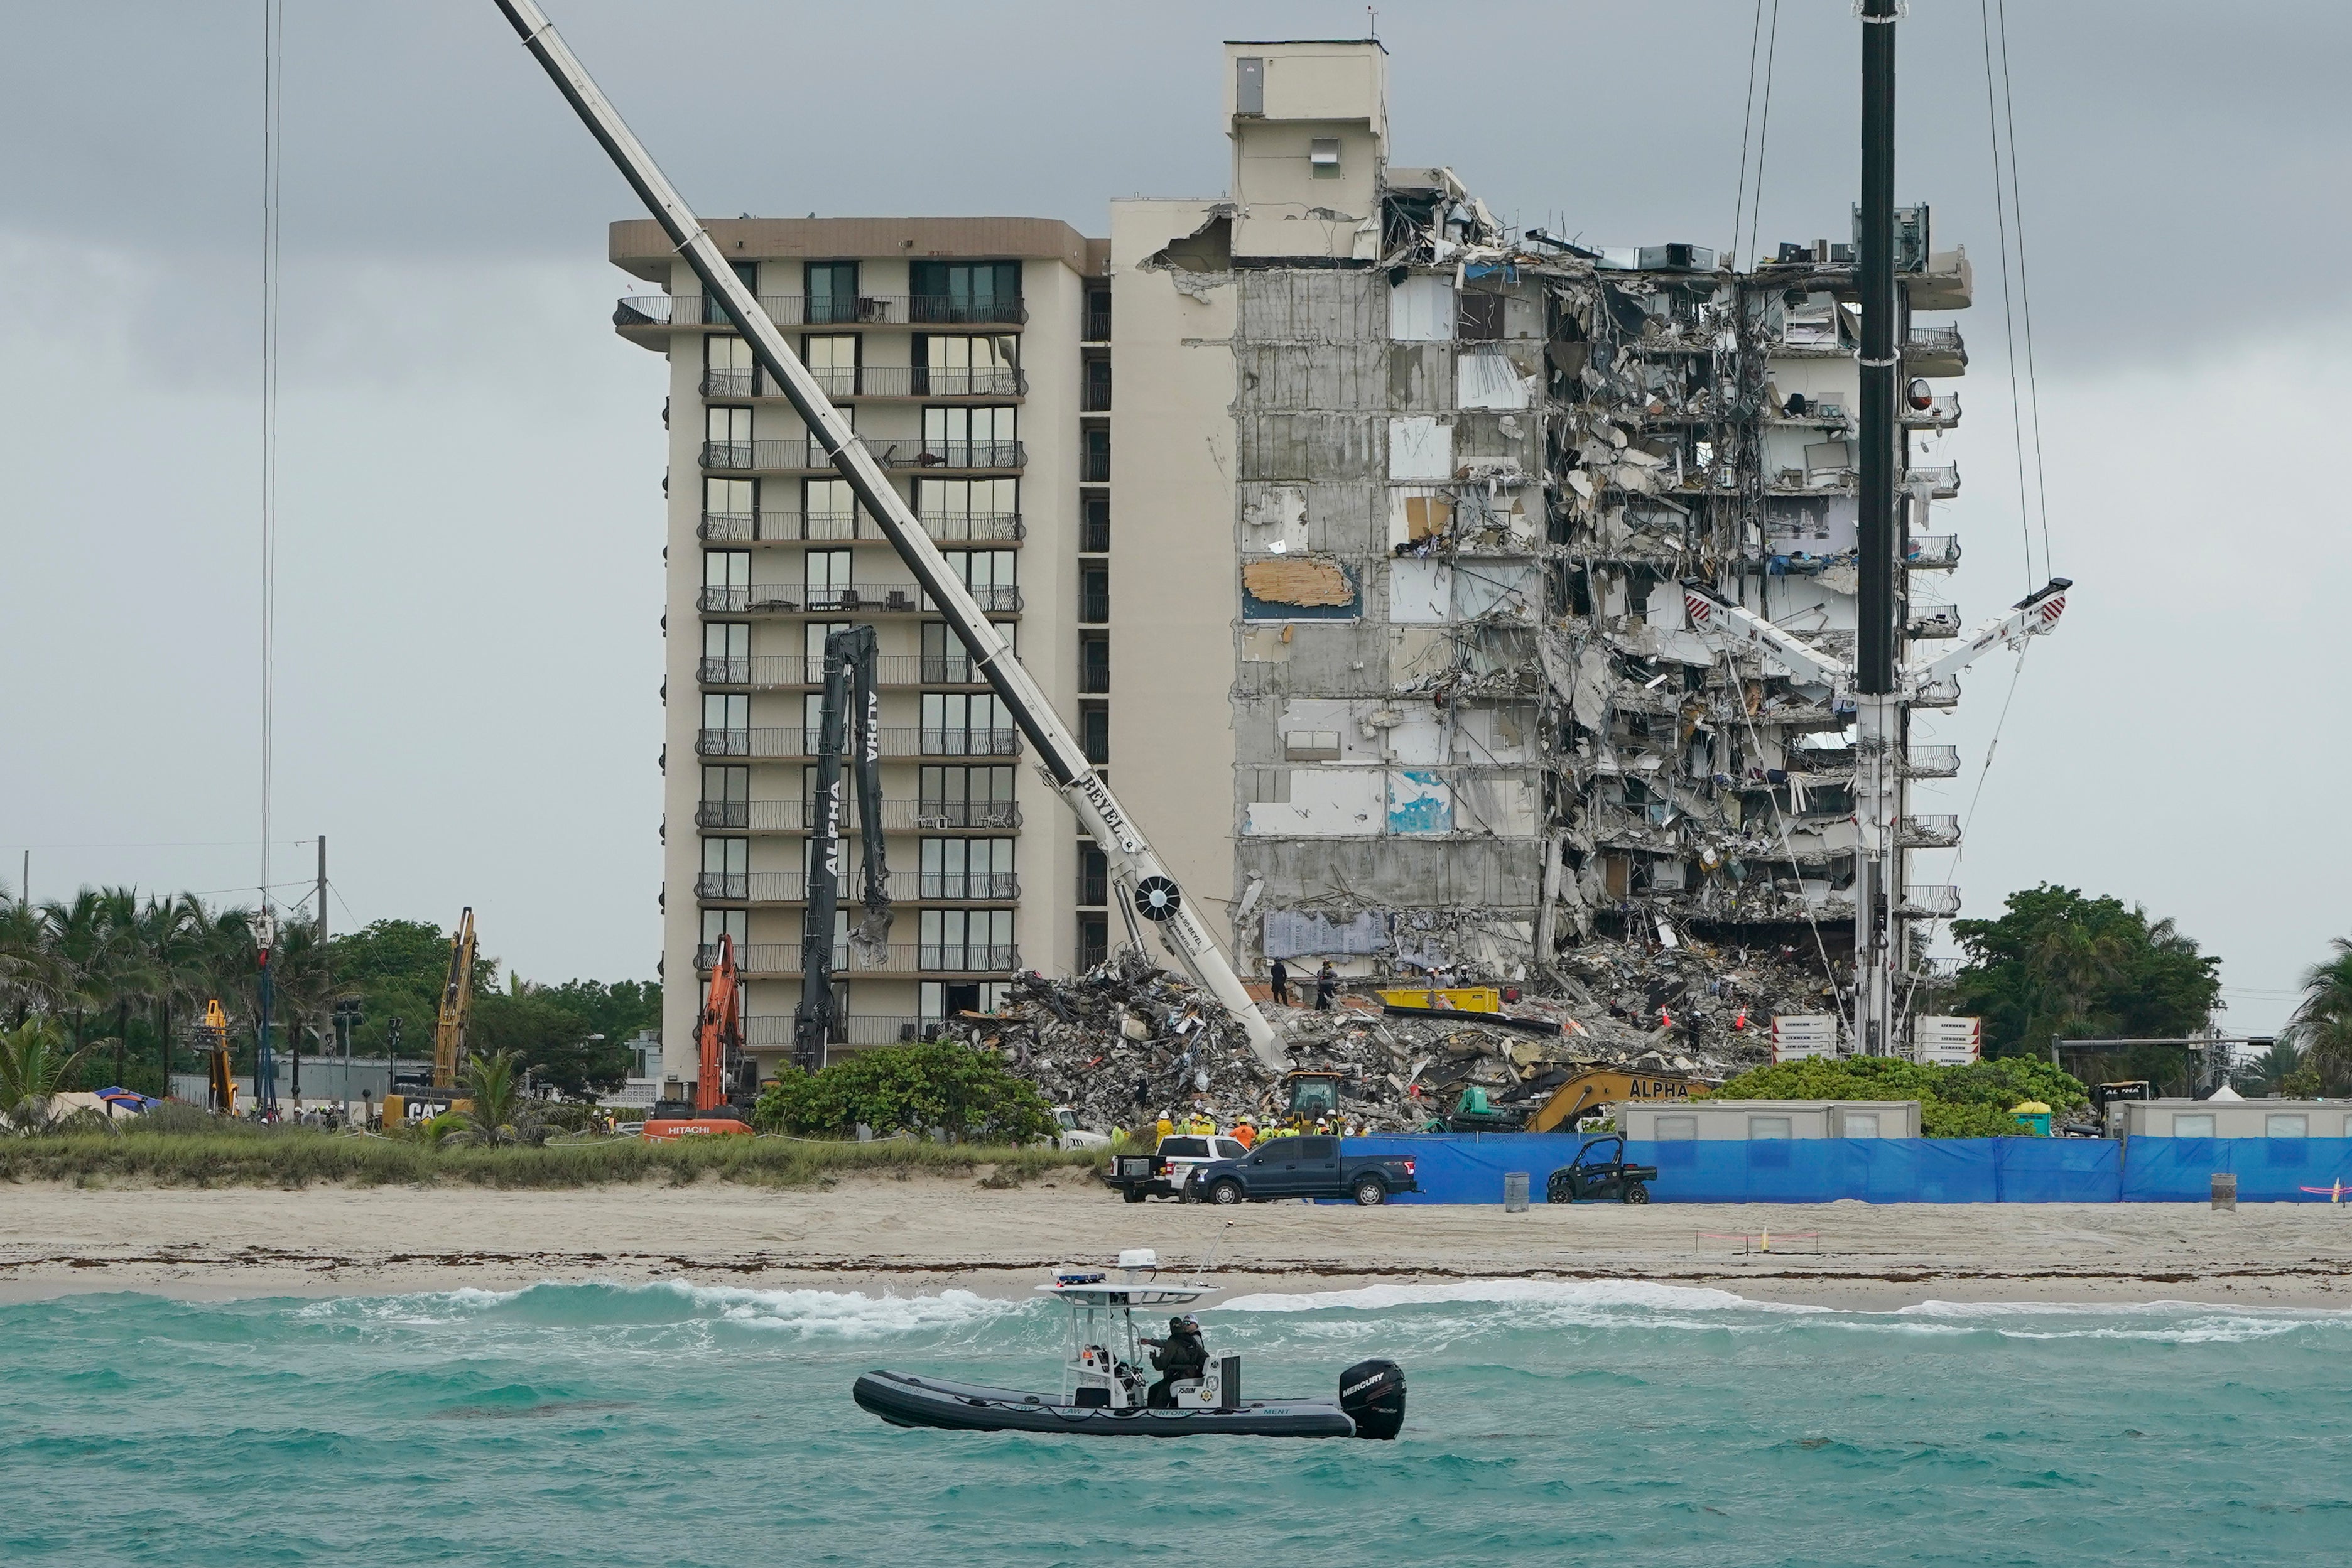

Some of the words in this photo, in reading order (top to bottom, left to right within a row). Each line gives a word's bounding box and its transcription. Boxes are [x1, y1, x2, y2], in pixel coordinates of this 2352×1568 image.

[866, 691, 878, 762] ALPHA
[1083, 776, 1124, 834] BEYEL
[825, 780, 840, 877] ALPHA
[1629, 1079, 1688, 1098] ALPHA
[668, 1126, 710, 1134] HITACHI
[1342, 1373, 1384, 1398] MERCURY
